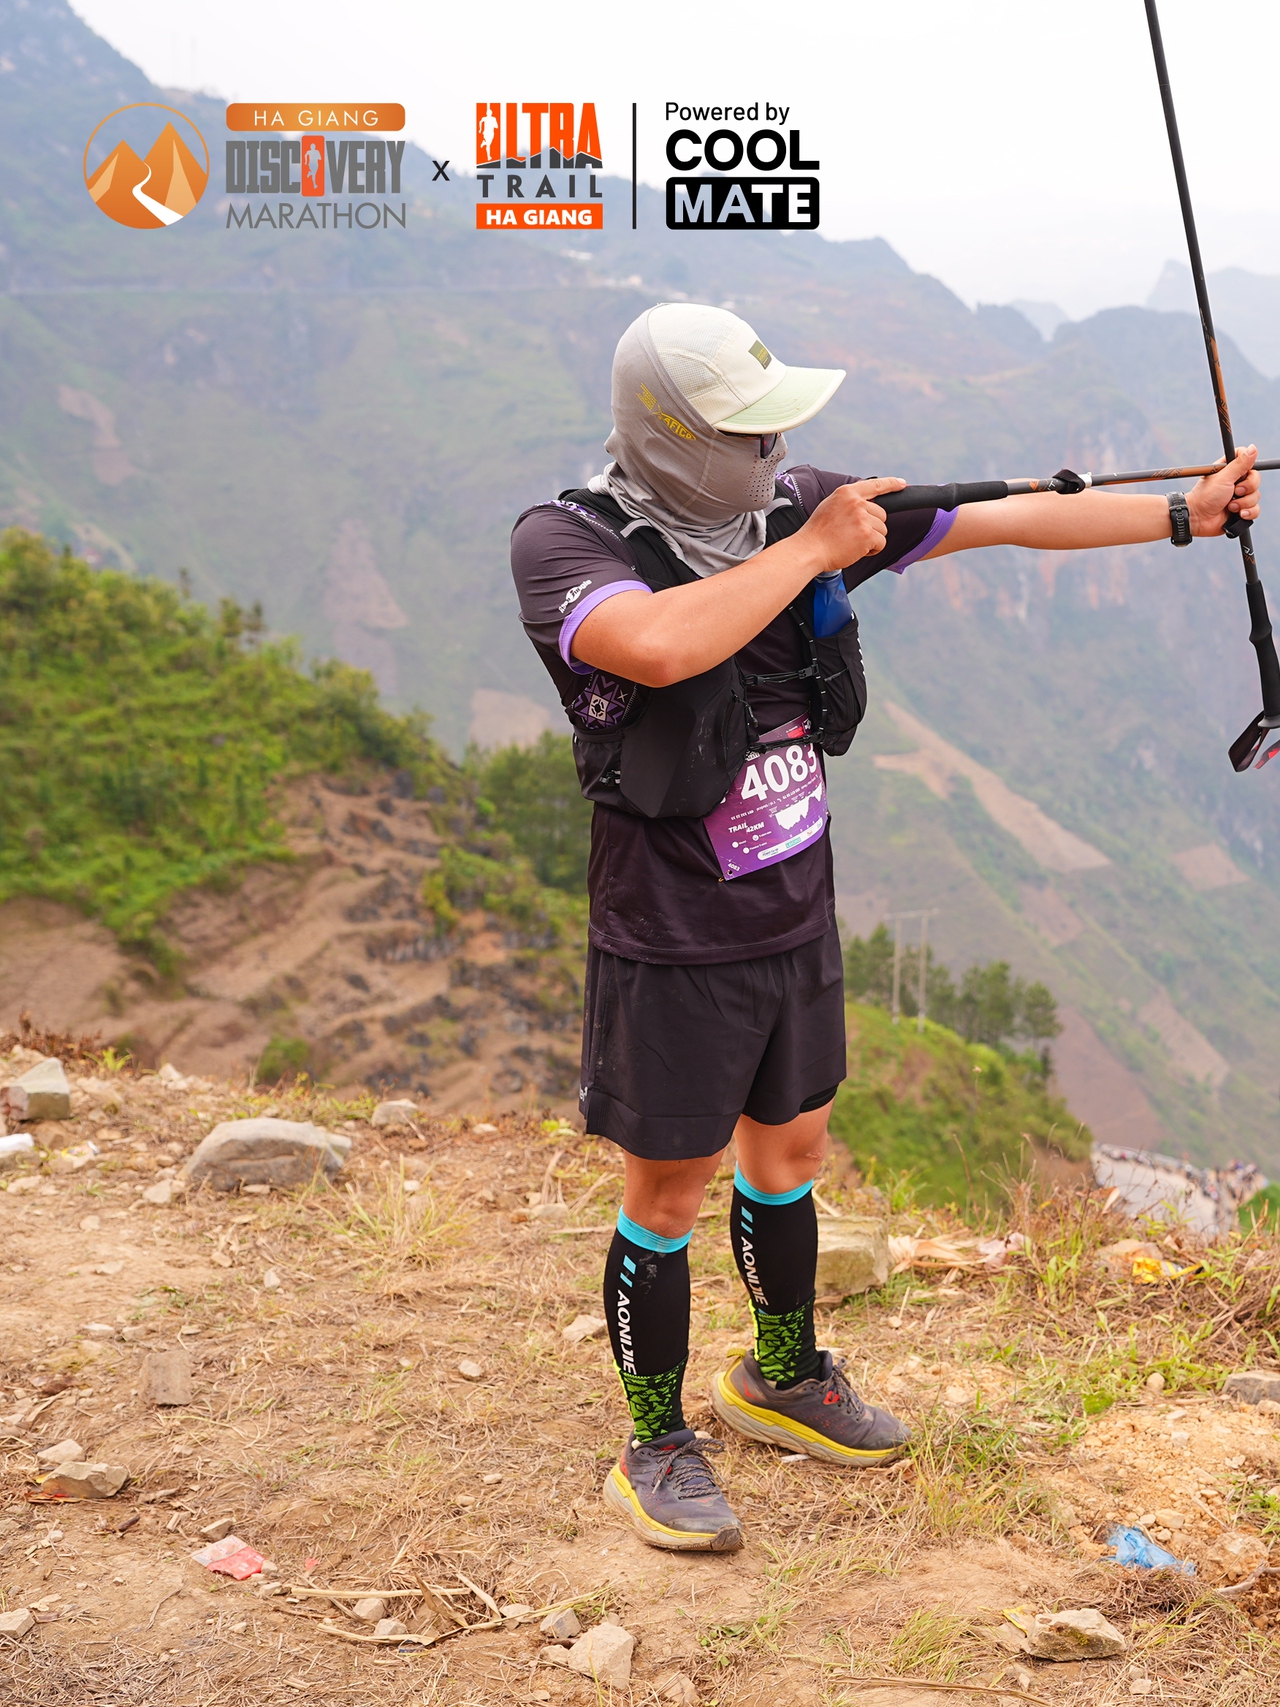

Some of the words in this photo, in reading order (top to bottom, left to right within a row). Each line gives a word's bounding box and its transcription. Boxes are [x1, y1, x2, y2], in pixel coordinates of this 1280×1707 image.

[740, 743, 817, 802] 4083
[728, 822, 748, 834] TRAIL
[745, 822, 765, 834] 42KM
[741, 1235, 769, 1306] AONIJIE
[617, 1288, 637, 1376] AONIJIE
